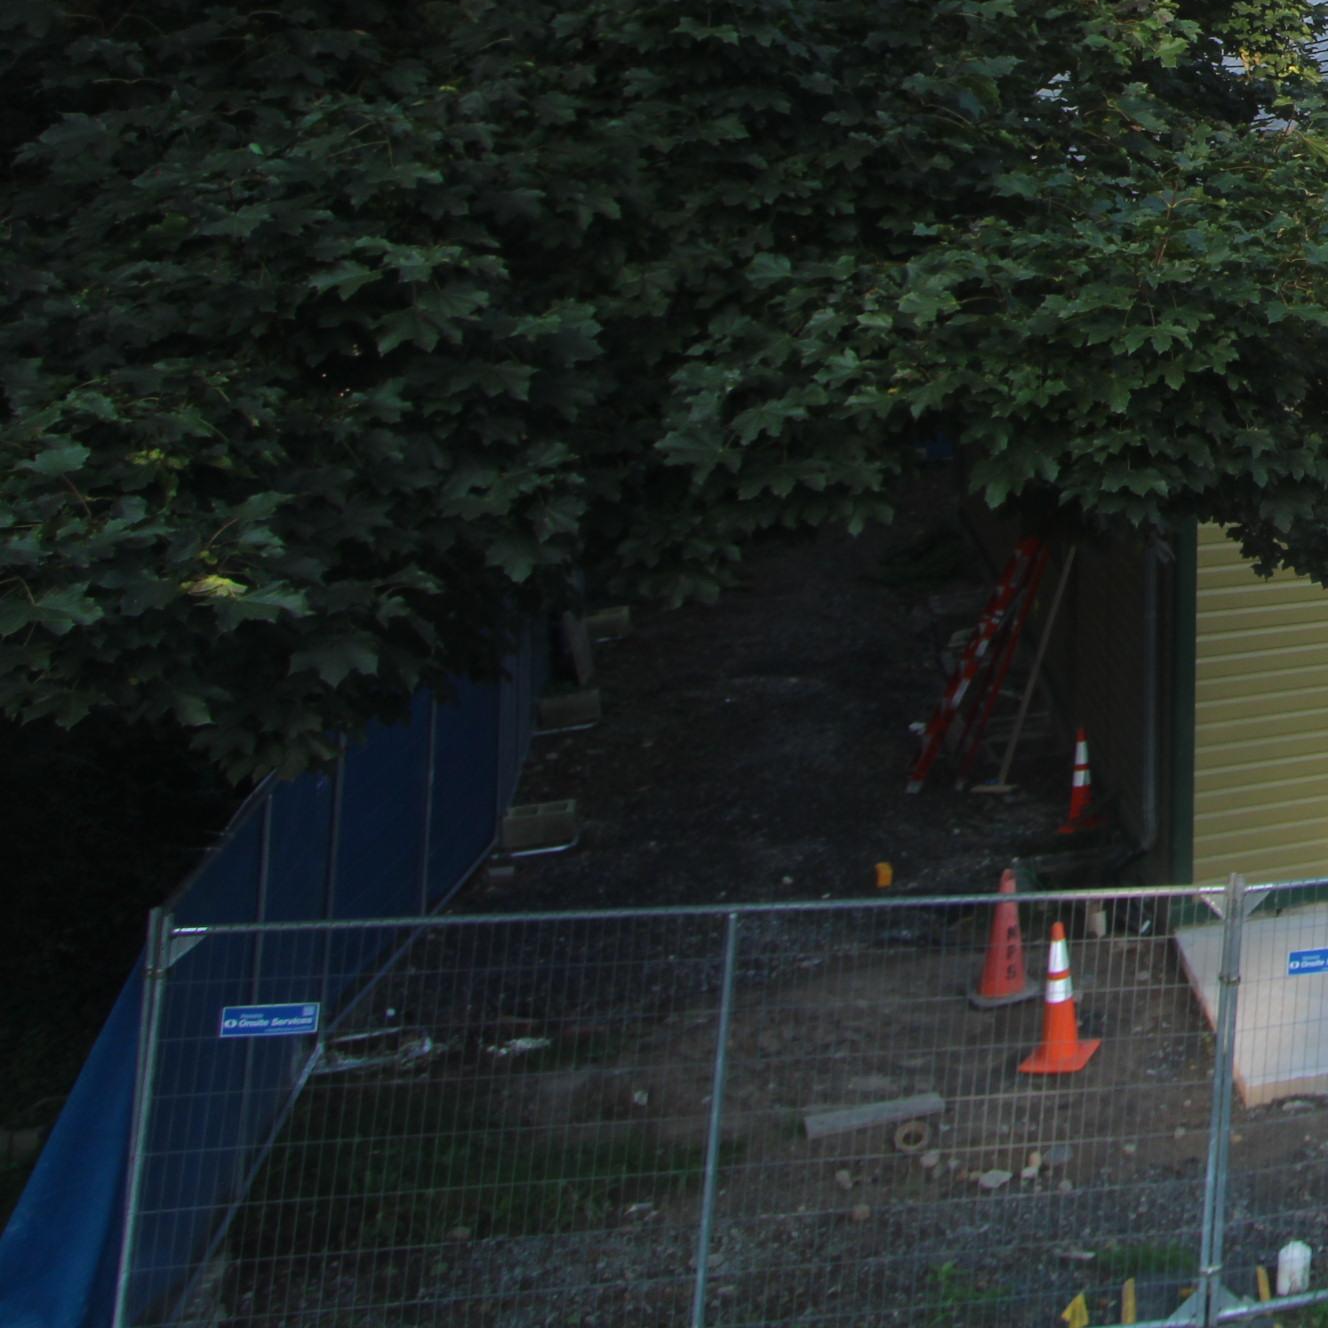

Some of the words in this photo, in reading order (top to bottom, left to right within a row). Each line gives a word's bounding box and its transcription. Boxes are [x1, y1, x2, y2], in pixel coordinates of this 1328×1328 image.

[1300, 960, 1325, 969] Onsite
[238, 1018, 270, 1028] Onsite
[271, 1016, 313, 1027] Services
